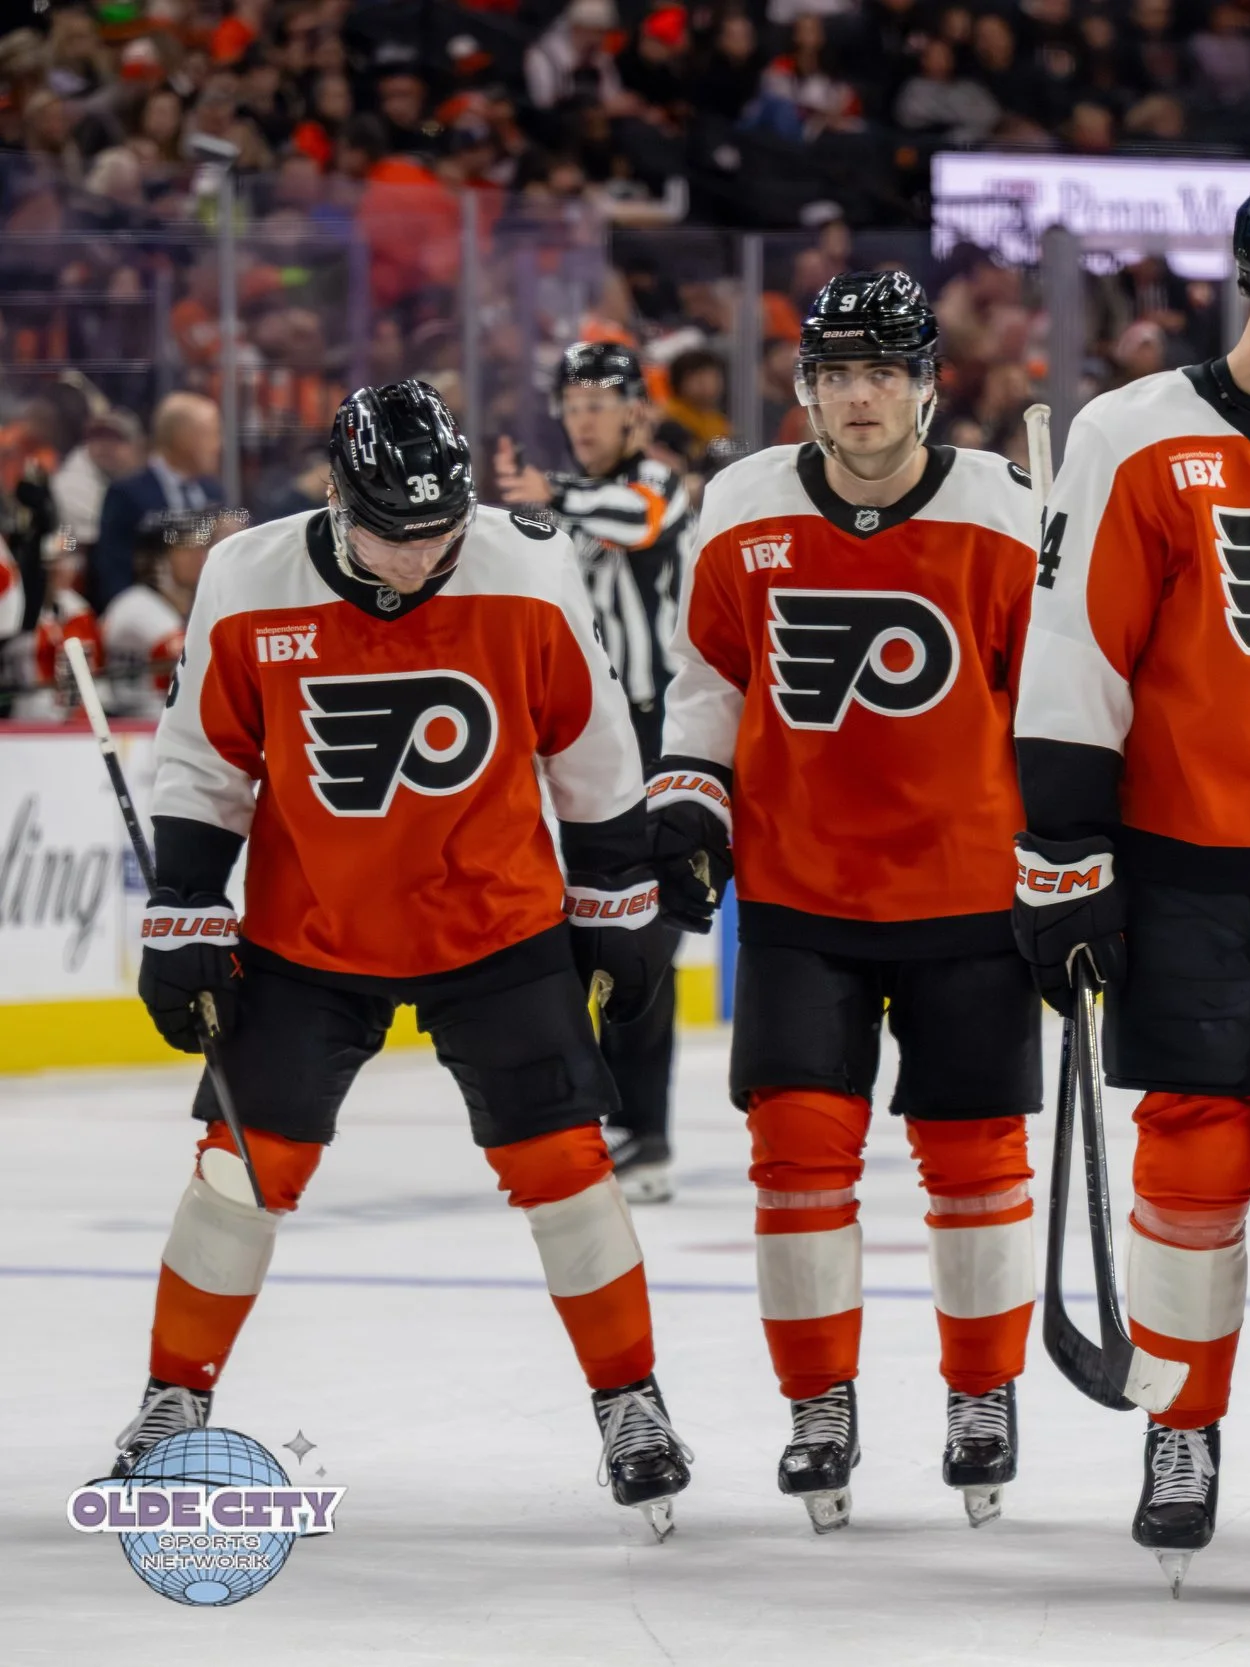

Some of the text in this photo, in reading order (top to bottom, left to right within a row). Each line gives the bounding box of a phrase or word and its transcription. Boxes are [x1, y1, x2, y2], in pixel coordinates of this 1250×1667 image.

[839, 294, 858, 312] 9
[822, 330, 865, 339] BAUER
[1171, 460, 1226, 490] IBX
[407, 473, 440, 503] 36
[404, 518, 448, 530] BAUER
[741, 542, 792, 573] IBX
[1037, 505, 1068, 590] 4
[256, 623, 308, 635] Independence
[256, 632, 319, 663] IBX
[141, 917, 239, 938] BAUER
